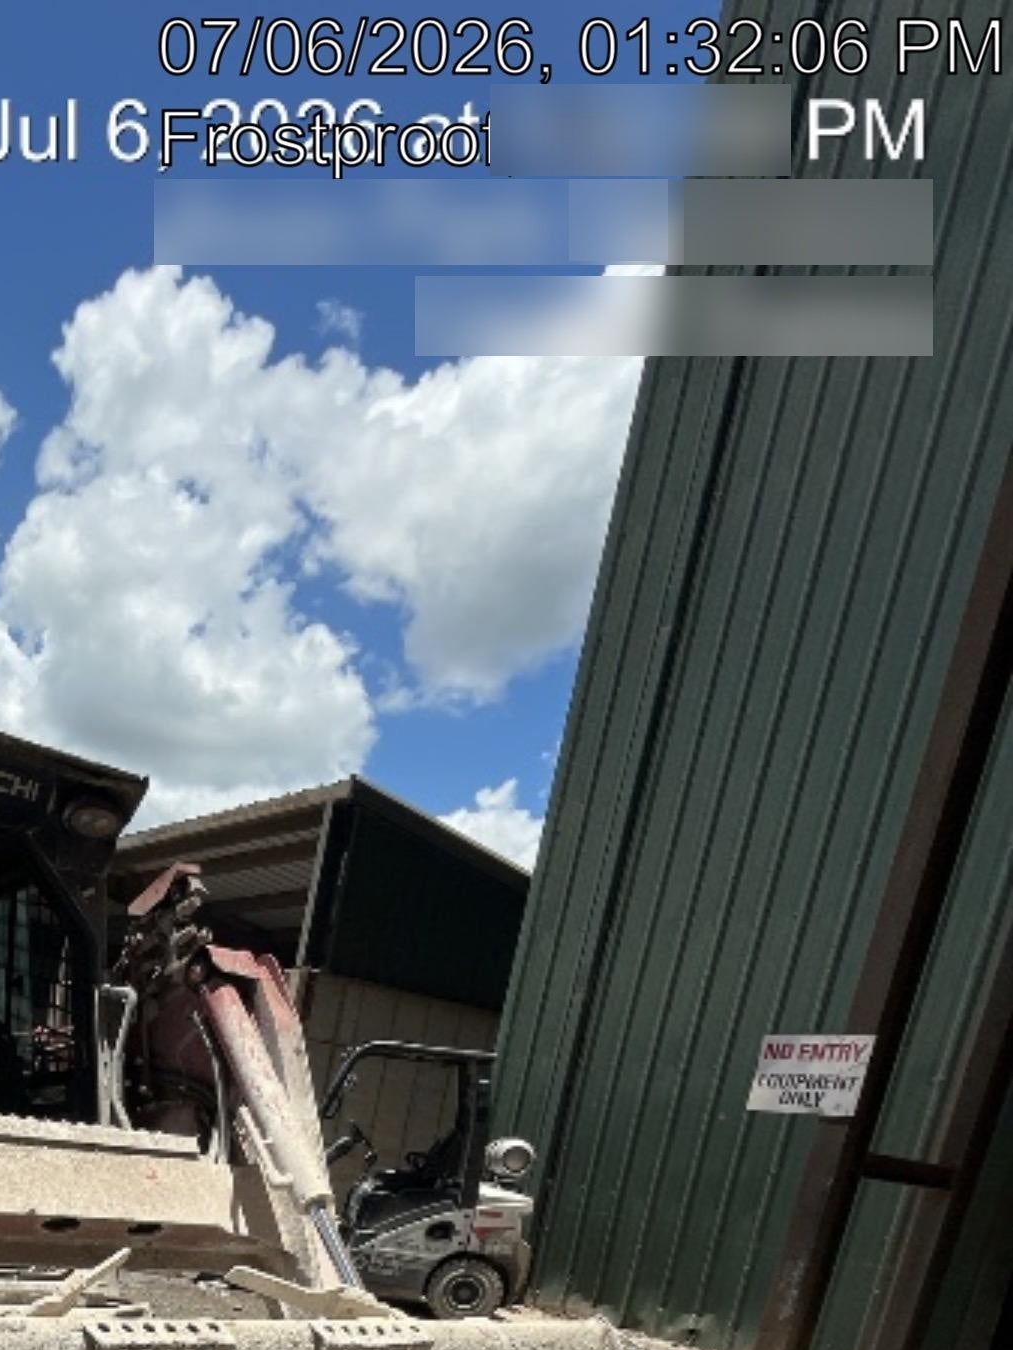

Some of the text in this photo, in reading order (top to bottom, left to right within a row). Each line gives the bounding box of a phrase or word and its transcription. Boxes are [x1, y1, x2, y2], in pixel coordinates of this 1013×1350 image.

[764, 1043, 868, 1062] NO ENTRY
[779, 1091, 825, 1107] ONLY
